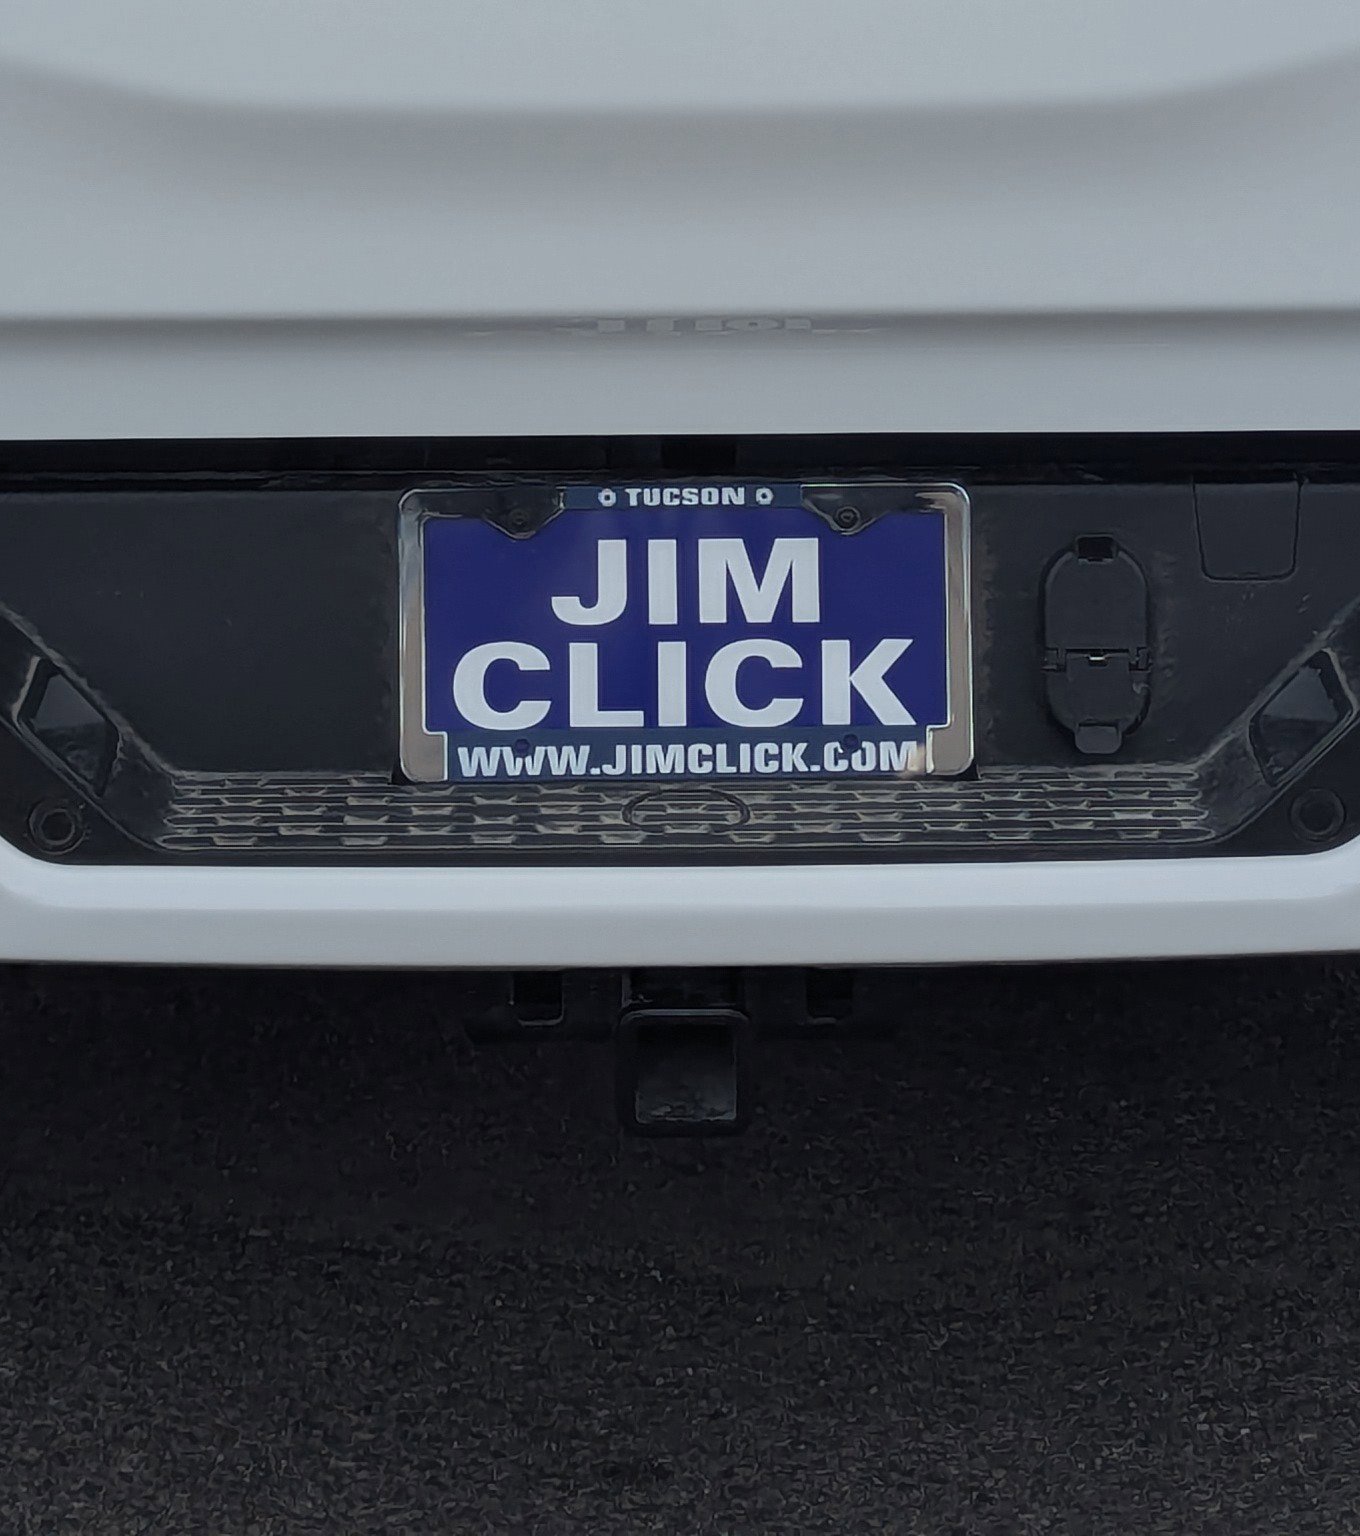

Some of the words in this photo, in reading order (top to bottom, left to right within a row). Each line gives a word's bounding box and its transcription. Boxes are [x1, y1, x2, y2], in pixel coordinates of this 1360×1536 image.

[625, 486, 745, 507] TUCSON
[551, 537, 821, 626] JIM
[452, 638, 918, 732] CLICK
[456, 739, 920, 779] WWW.JIMCLICK.COM
